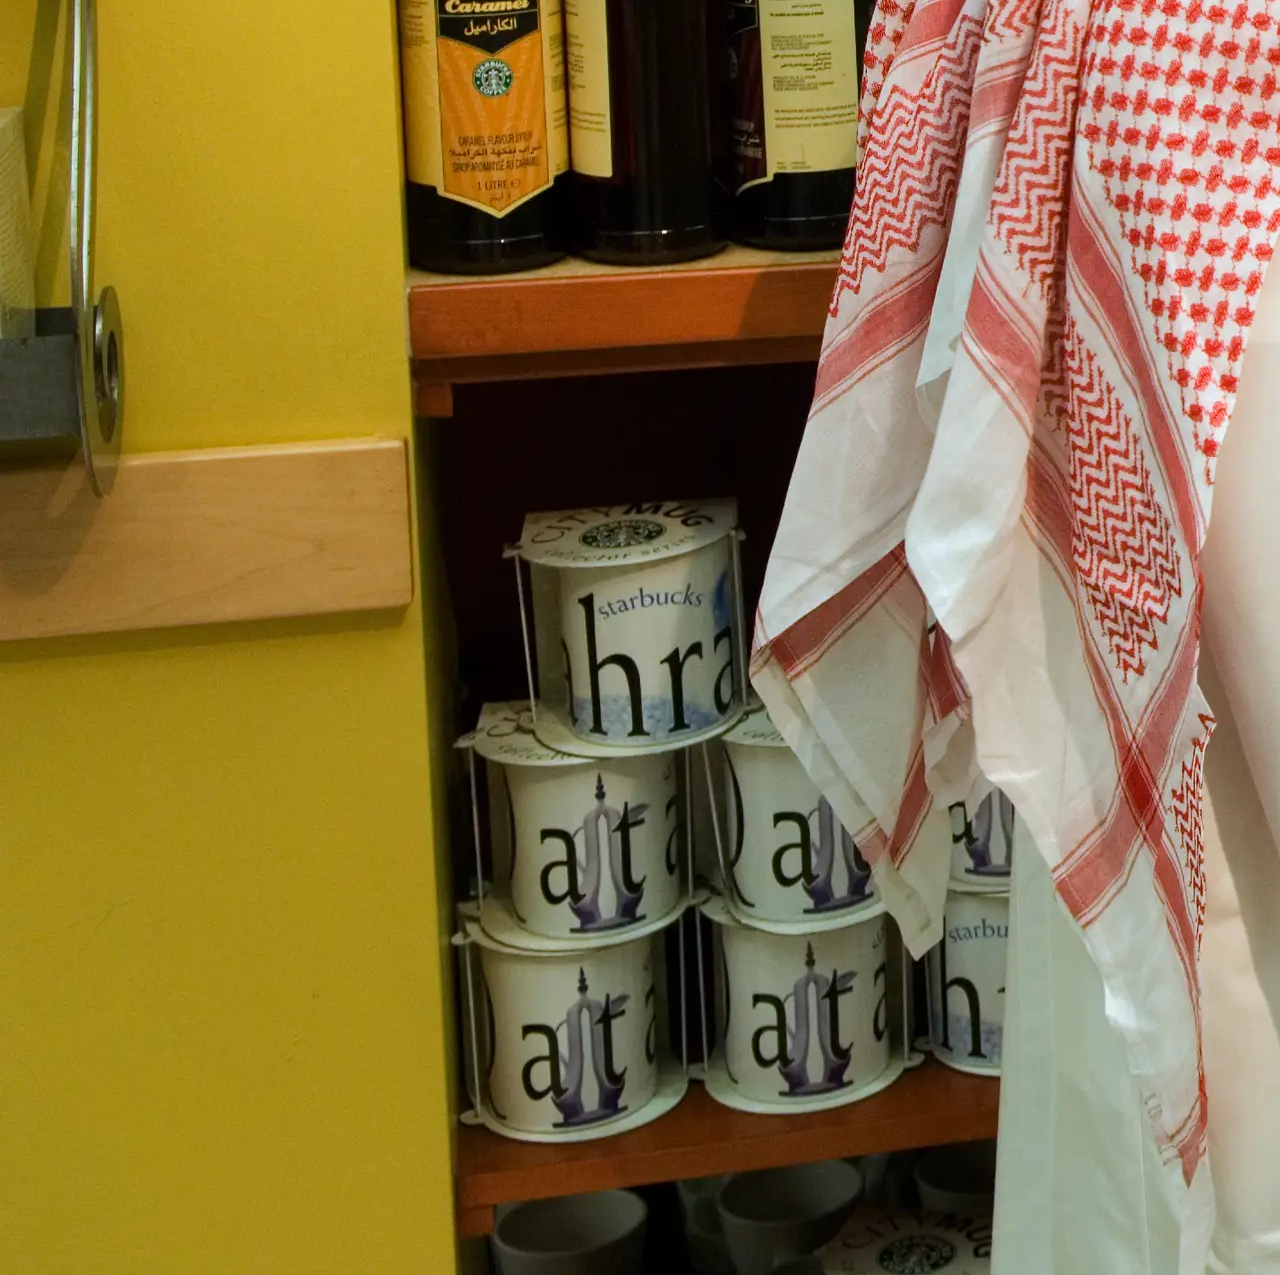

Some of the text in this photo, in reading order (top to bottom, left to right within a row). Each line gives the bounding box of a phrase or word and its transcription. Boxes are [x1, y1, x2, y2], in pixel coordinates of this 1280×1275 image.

[464, 18, 517, 36] الكاراميل
[475, 60, 511, 78] STARBUCKS
[479, 85, 507, 97] COFFEE
[458, 136, 486, 147] CARAMEL
[485, 179, 507, 190] LITRE
[531, 508, 611, 544] CITY
[623, 503, 714, 528] MUG
[598, 582, 704, 620] starbucks
[562, 592, 736, 737] hra
